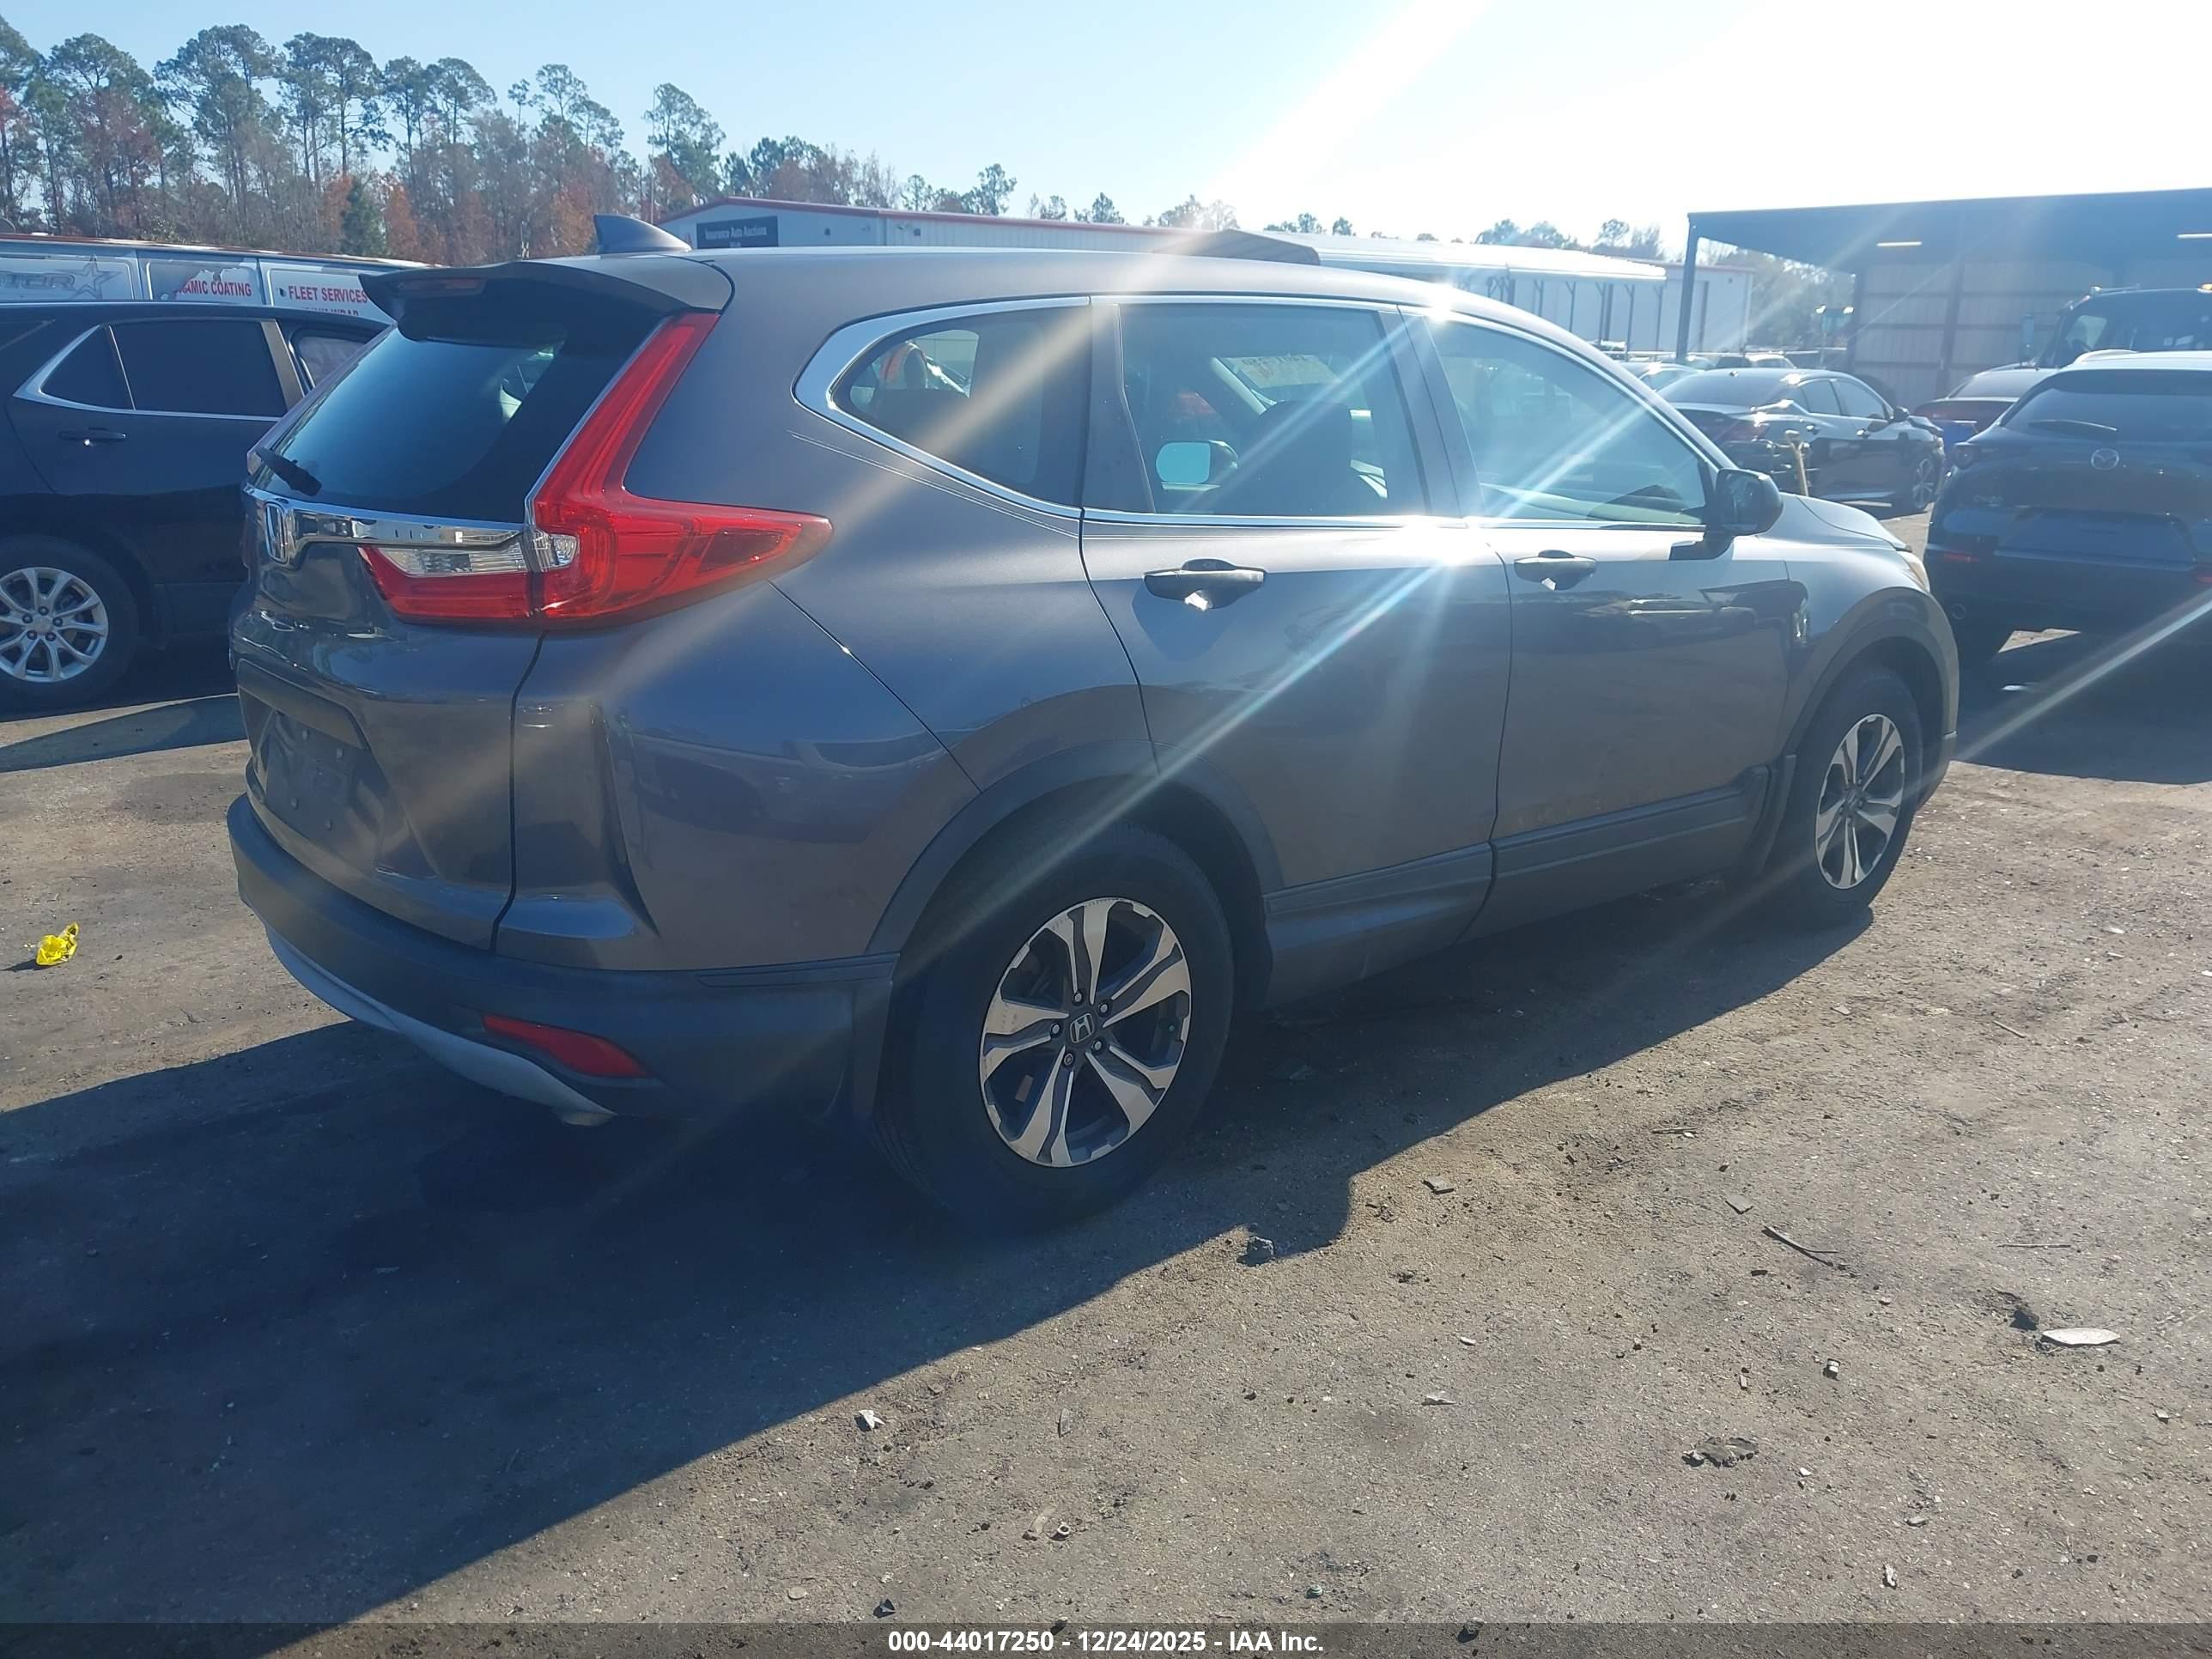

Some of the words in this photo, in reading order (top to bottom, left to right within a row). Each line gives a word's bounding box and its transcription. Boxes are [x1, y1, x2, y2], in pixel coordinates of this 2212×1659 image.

[210, 280, 252, 297] COATING
[288, 285, 319, 301] FLEET
[321, 287, 368, 304] SERVICES
